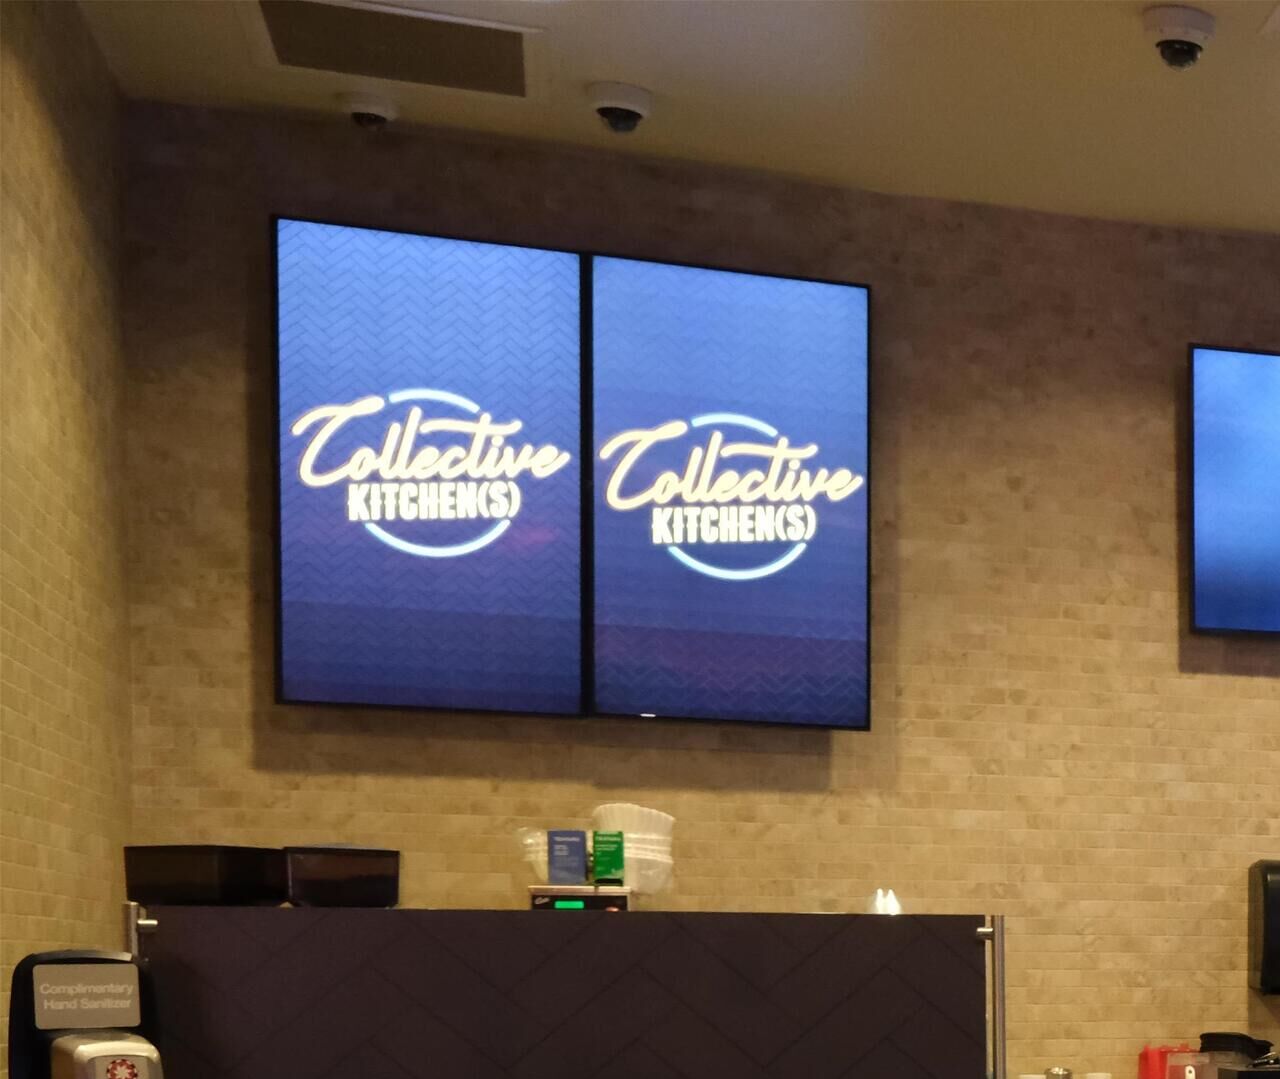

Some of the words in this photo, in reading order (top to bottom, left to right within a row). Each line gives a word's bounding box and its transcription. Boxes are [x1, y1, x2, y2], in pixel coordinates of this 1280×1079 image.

[292, 396, 572, 487] Collective
[600, 420, 864, 511] Collective
[348, 481, 521, 521] KITCHEN(S)
[651, 505, 817, 545] KITCHEN(S)
[40, 983, 135, 996] Complimentary
[44, 999, 78, 1010] Hand
[80, 998, 132, 1009] Sanitizer
